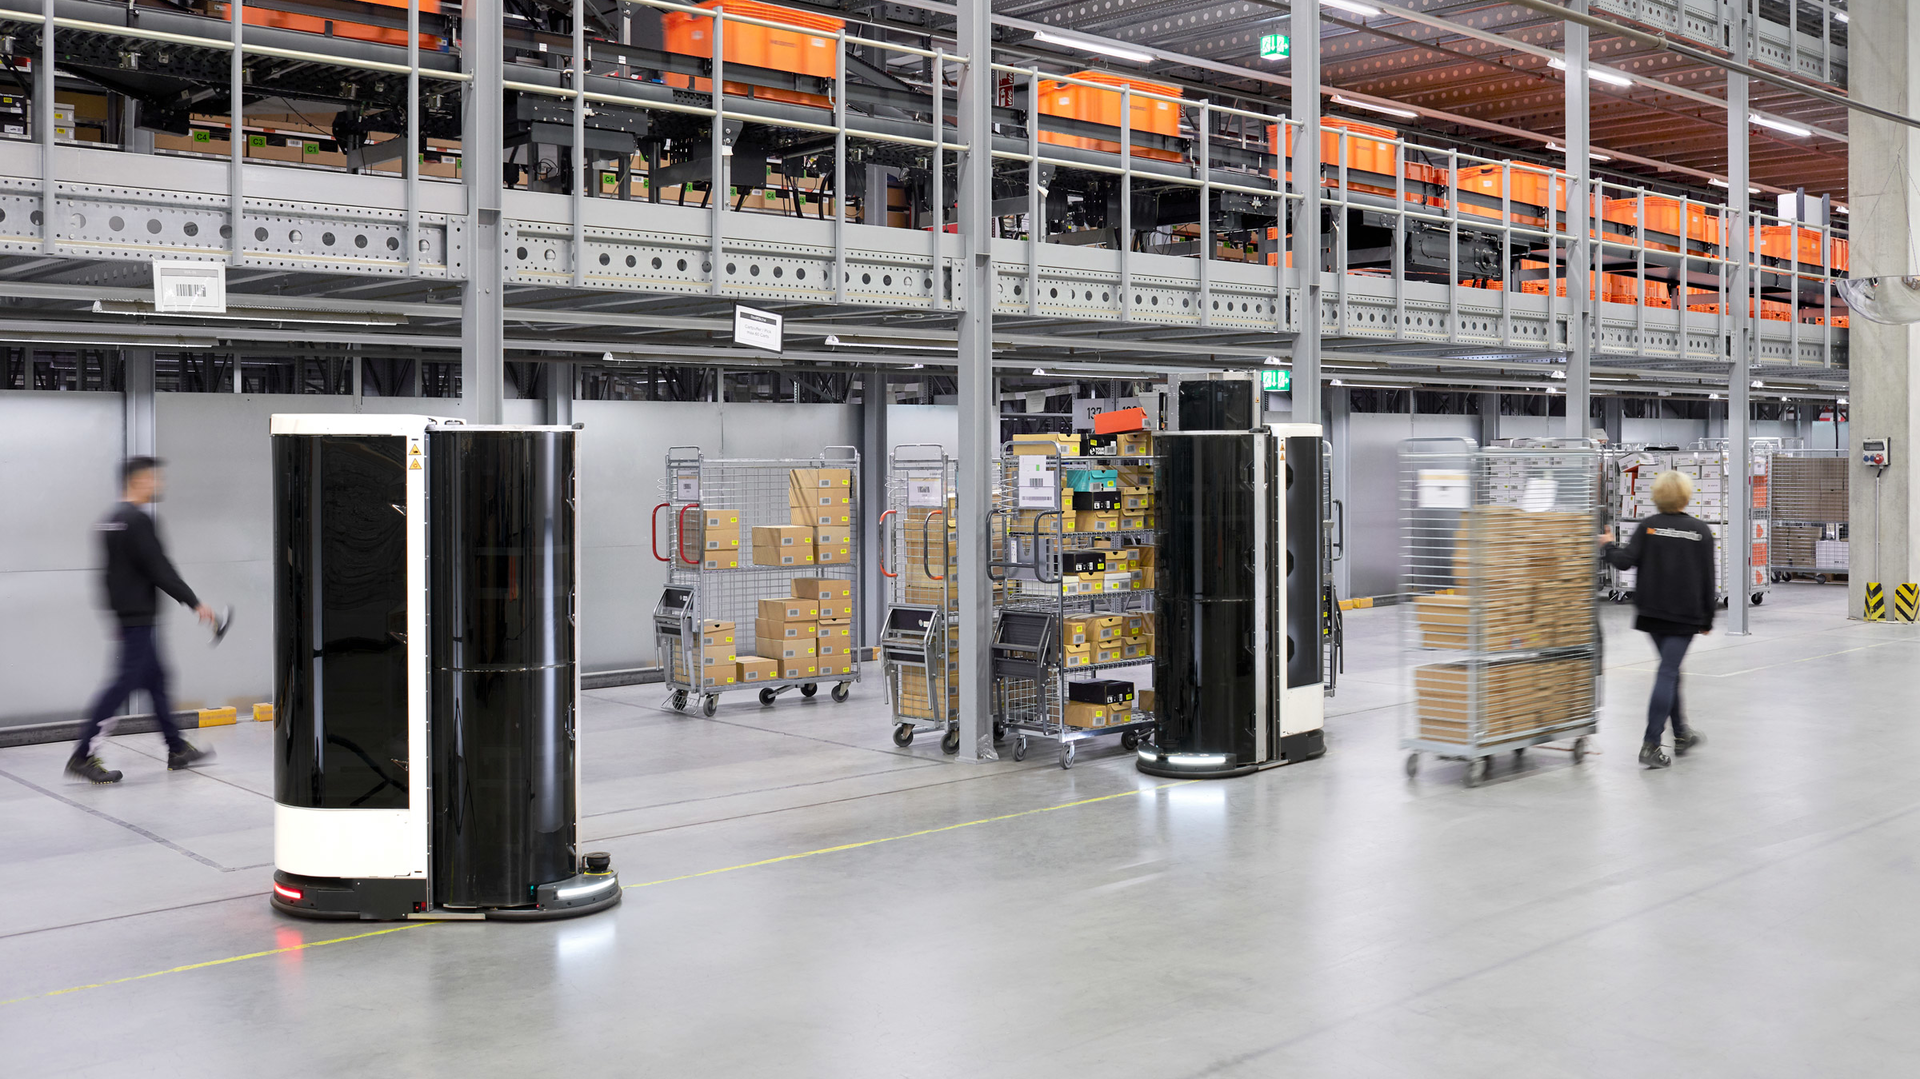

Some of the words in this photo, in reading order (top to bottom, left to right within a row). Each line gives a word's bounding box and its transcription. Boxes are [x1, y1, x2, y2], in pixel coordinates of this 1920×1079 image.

[196, 133, 208, 141] C4
[253, 138, 264, 146] C3
[307, 144, 318, 152] C1
[1087, 407, 1102, 420] 137
